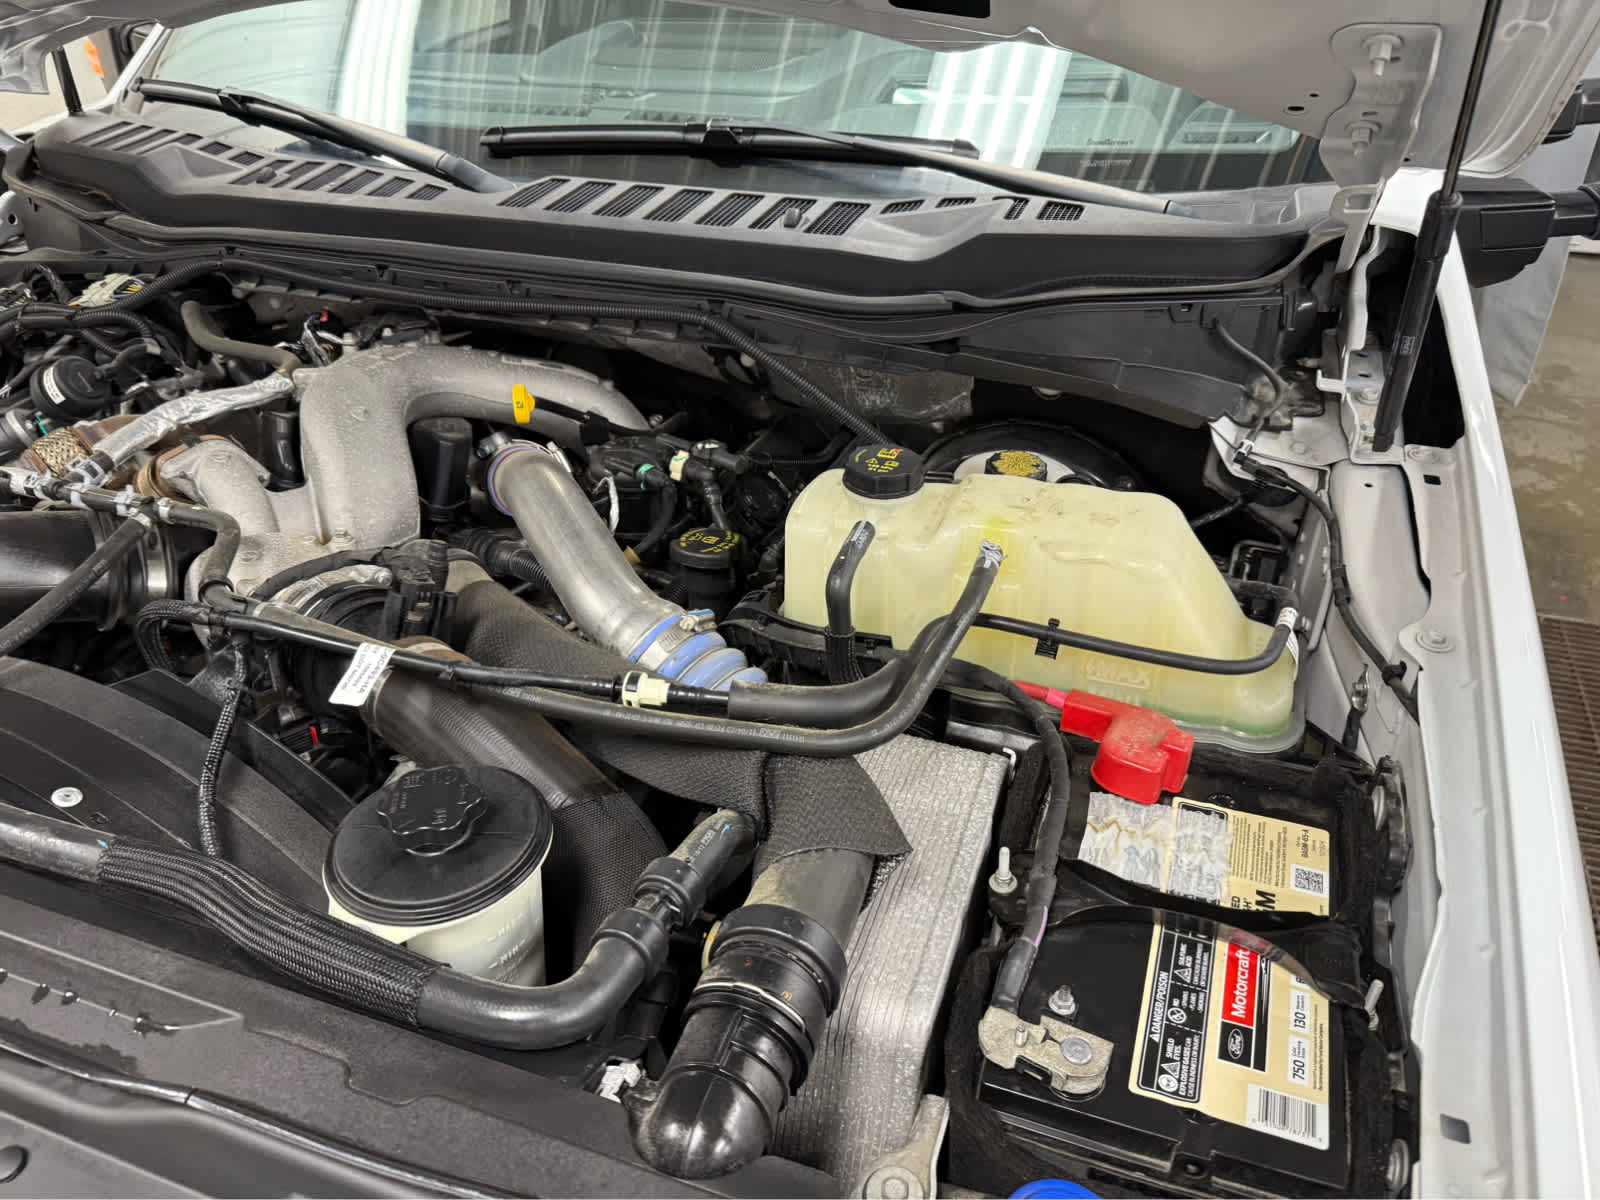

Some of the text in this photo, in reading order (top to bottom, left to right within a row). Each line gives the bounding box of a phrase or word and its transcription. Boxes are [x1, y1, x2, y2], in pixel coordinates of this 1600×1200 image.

[1231, 949, 1251, 1018] Motorcraft
[1151, 970, 1169, 1033] DANGER/POISON
[1294, 1011, 1306, 1029] 130
[1165, 1037, 1175, 1058] SHIELD
[1229, 1033, 1242, 1054] Ford
[1292, 1060, 1305, 1080] 750
